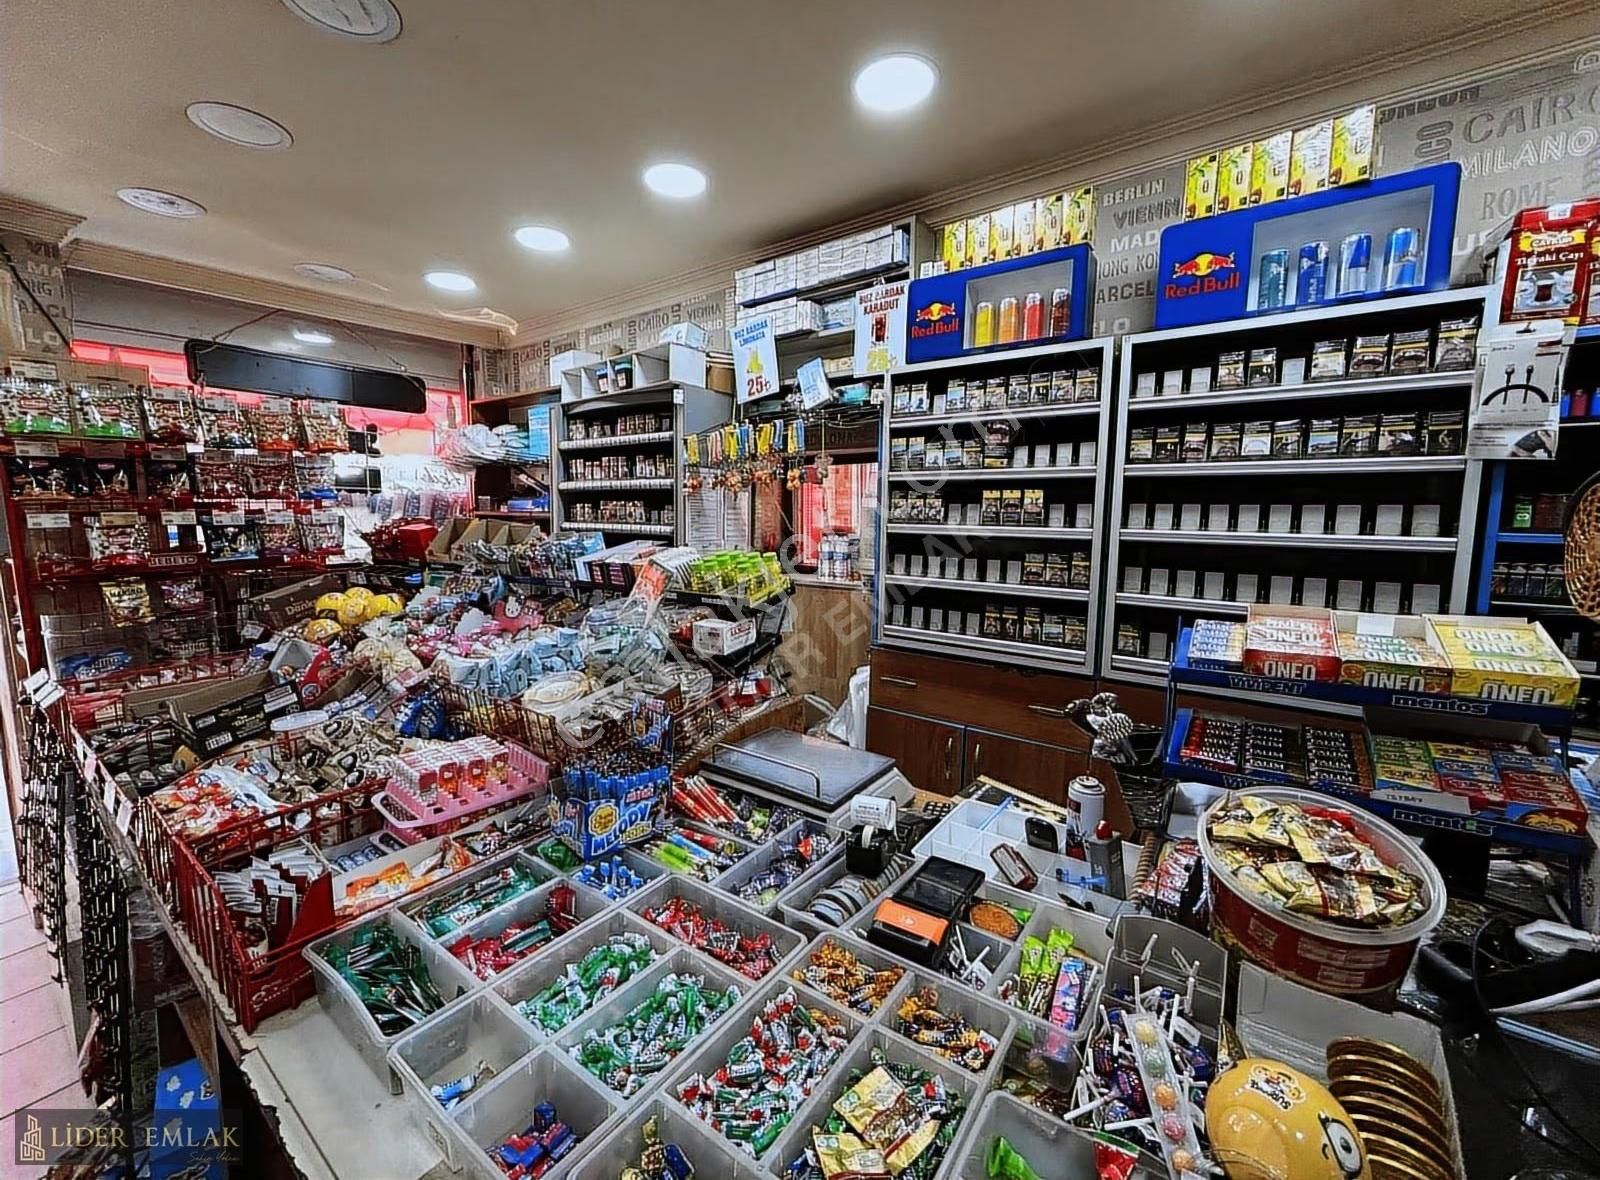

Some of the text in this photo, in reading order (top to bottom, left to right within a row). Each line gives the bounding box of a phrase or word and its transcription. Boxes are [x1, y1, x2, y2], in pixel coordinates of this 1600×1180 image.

[1459, 126, 1600, 180] MILANO
[1103, 179, 1165, 207] BERLIN
[1480, 176, 1563, 221] ROME
[1113, 197, 1183, 230] VIENN
[1110, 230, 1159, 254] MAD
[1166, 272, 1241, 300] Red Bull
[638, 312, 669, 332] CAIRO
[912, 319, 960, 339] Red Bull
[1392, 694, 1489, 715] mentos
